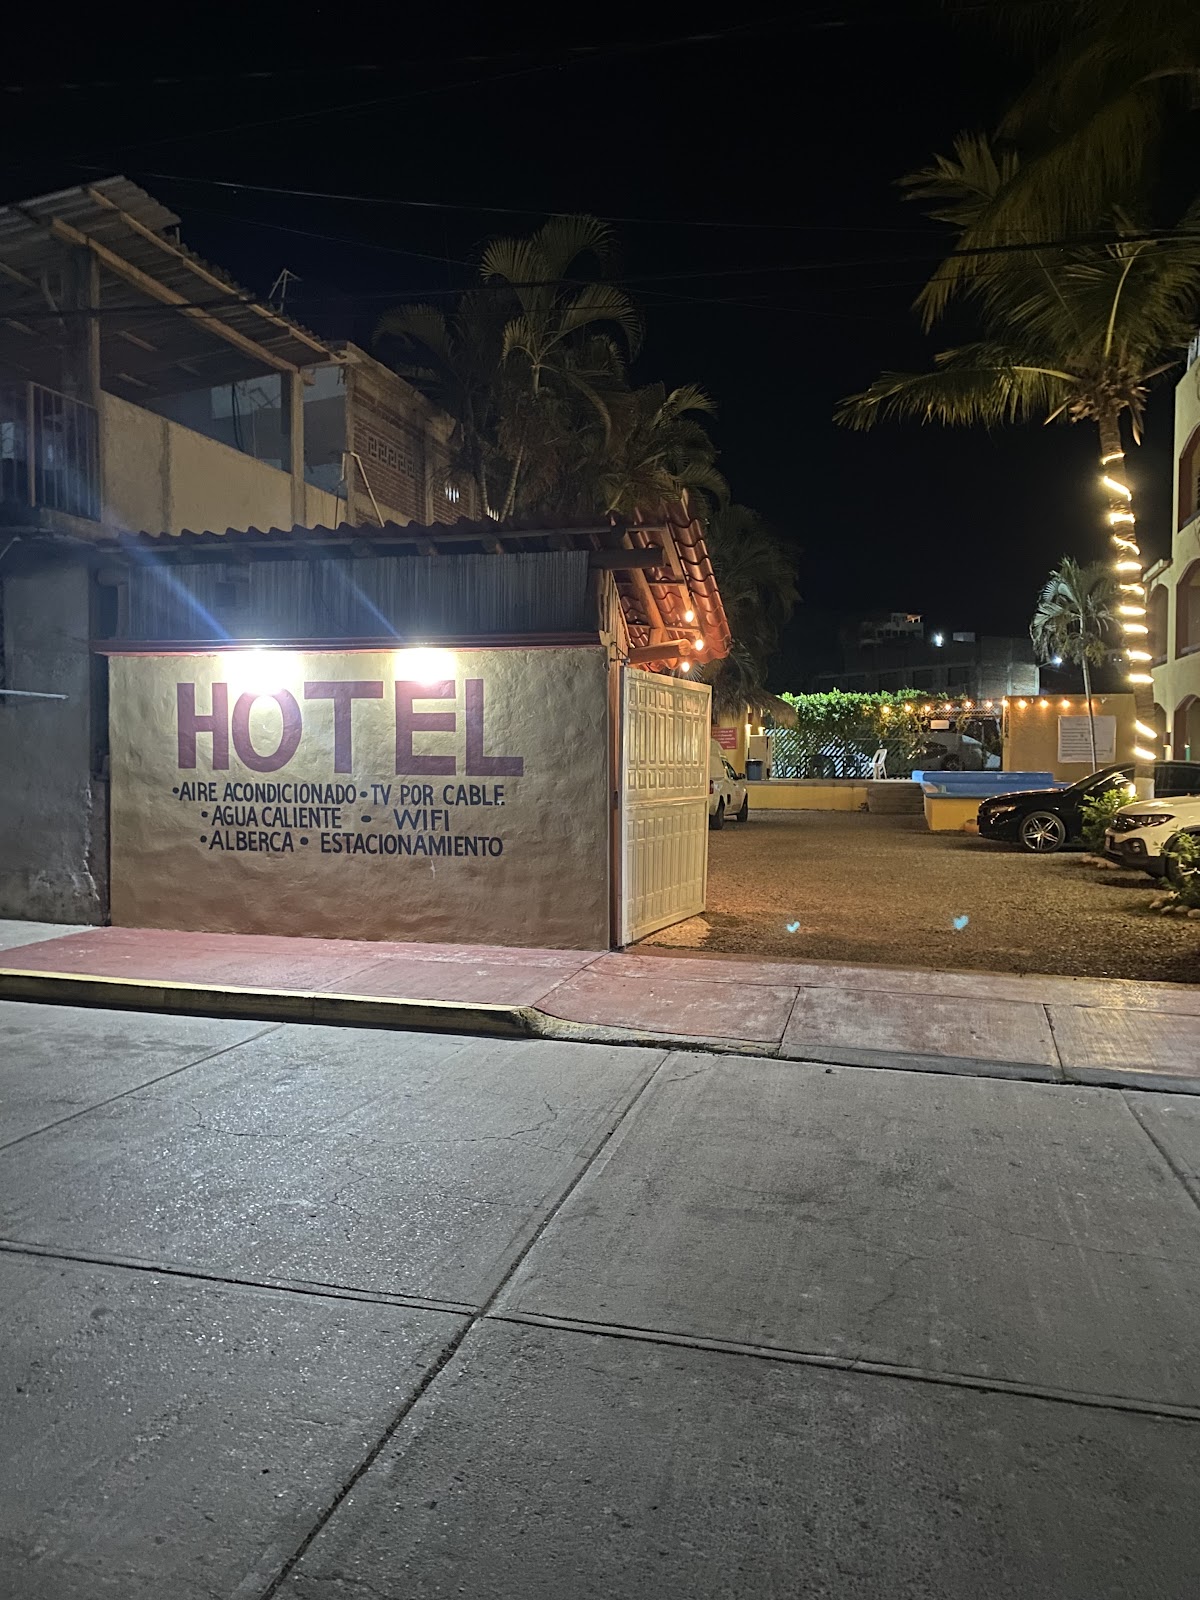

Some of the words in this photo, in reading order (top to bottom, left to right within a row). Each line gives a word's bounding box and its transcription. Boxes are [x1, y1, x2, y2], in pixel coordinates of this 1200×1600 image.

[176, 678, 524, 777] HOTEL
[179, 781, 218, 802] AIRE
[223, 782, 357, 804] ACONDICIONADO
[370, 784, 392, 806] TV
[400, 784, 434, 806] POR
[443, 784, 505, 806] CABLE
[211, 805, 259, 827] AGUA
[261, 806, 342, 829] CALIENTE
[393, 808, 450, 832] WIFI
[208, 830, 294, 853] ALBERCA
[320, 832, 504, 857] ESTACIONAMIENTO
